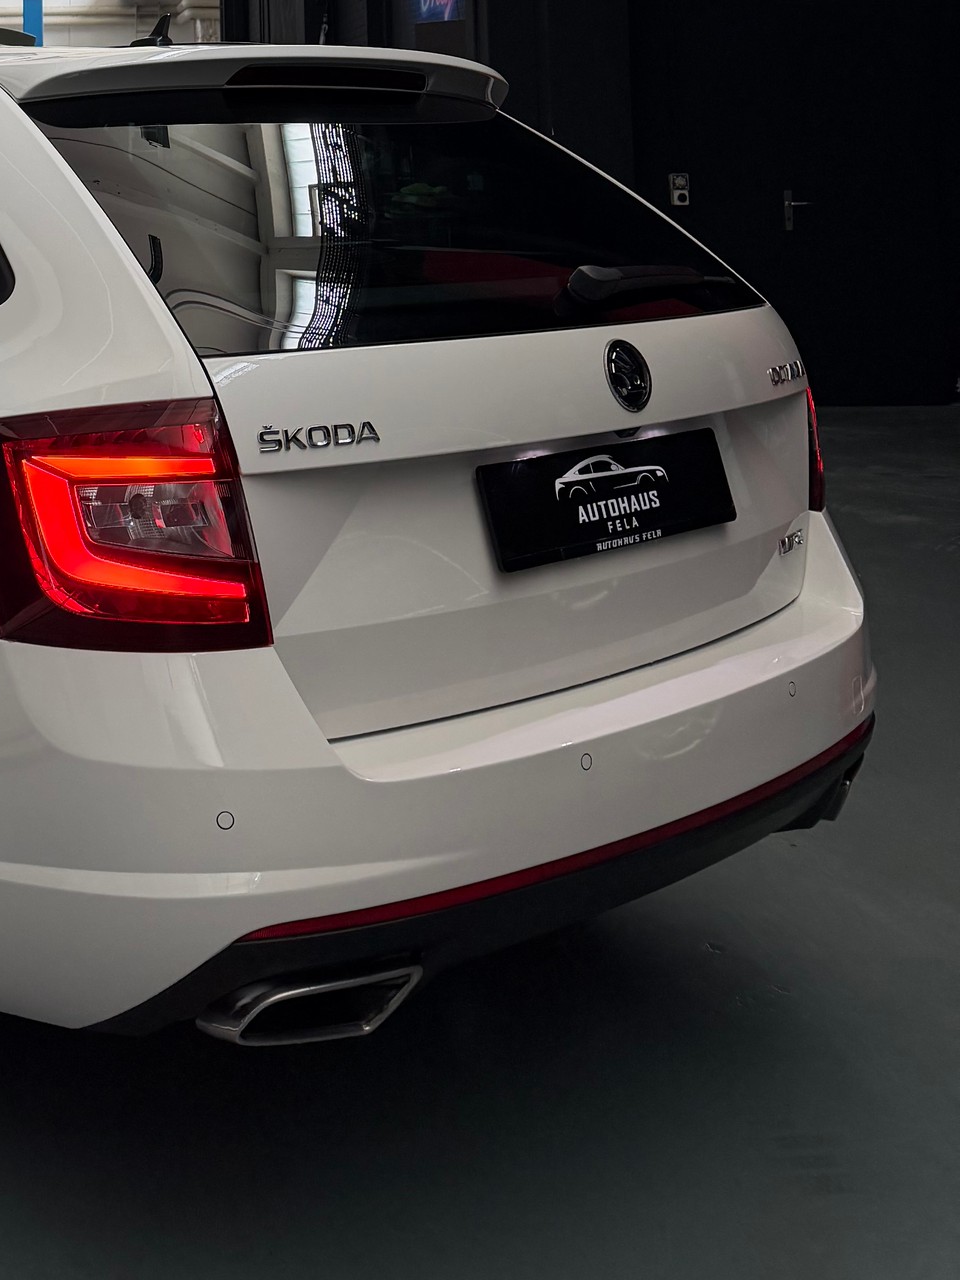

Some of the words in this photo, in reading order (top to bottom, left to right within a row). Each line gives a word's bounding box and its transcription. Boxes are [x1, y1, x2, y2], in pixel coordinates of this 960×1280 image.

[257, 421, 381, 453] ŠKODA
[578, 490, 661, 524] AUTOHAUS
[607, 516, 640, 534] FELA
[596, 534, 640, 552] AUTOHAUS
[642, 529, 662, 541] FELA
